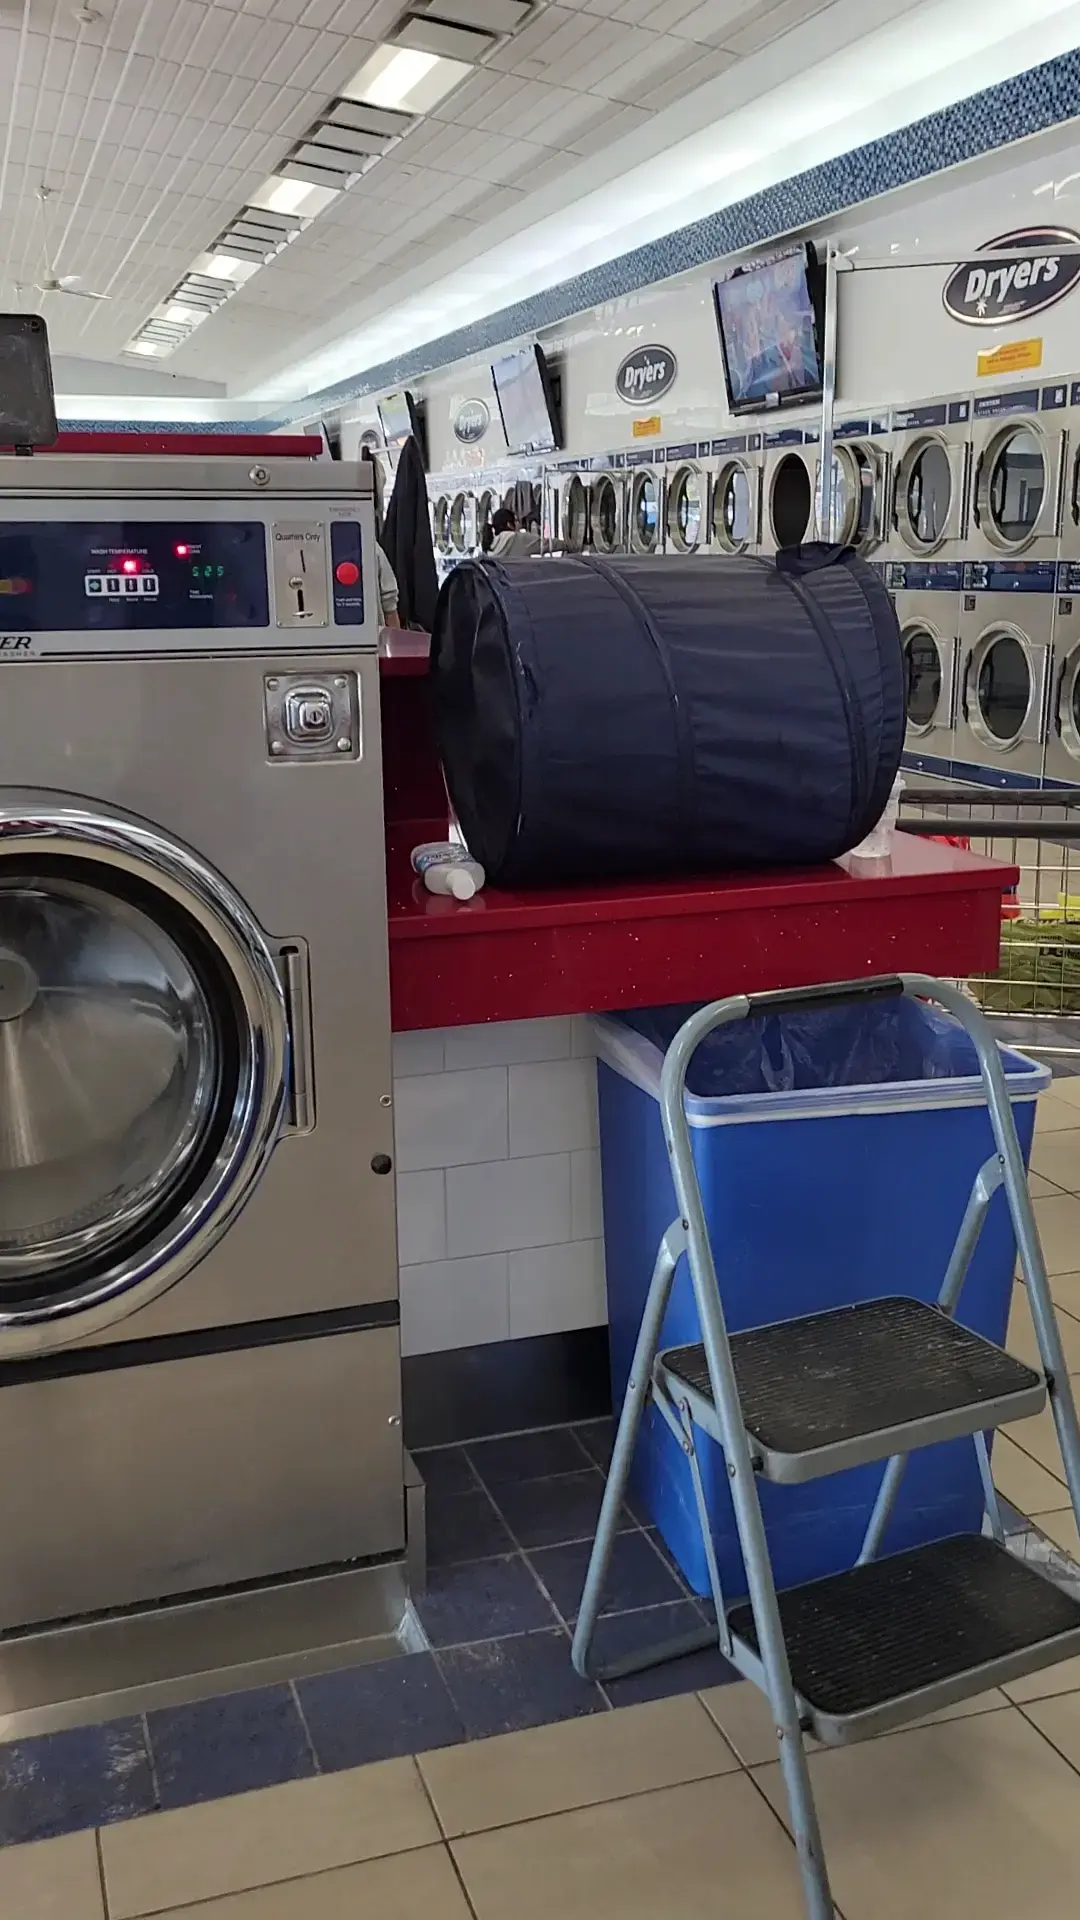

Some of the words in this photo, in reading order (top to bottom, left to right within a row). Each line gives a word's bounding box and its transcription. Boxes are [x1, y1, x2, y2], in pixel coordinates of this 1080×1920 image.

[963, 256, 1061, 303] Dryers
[624, 360, 666, 390] Dryers
[275, 532, 304, 541] Quarters
[305, 532, 321, 542] Only
